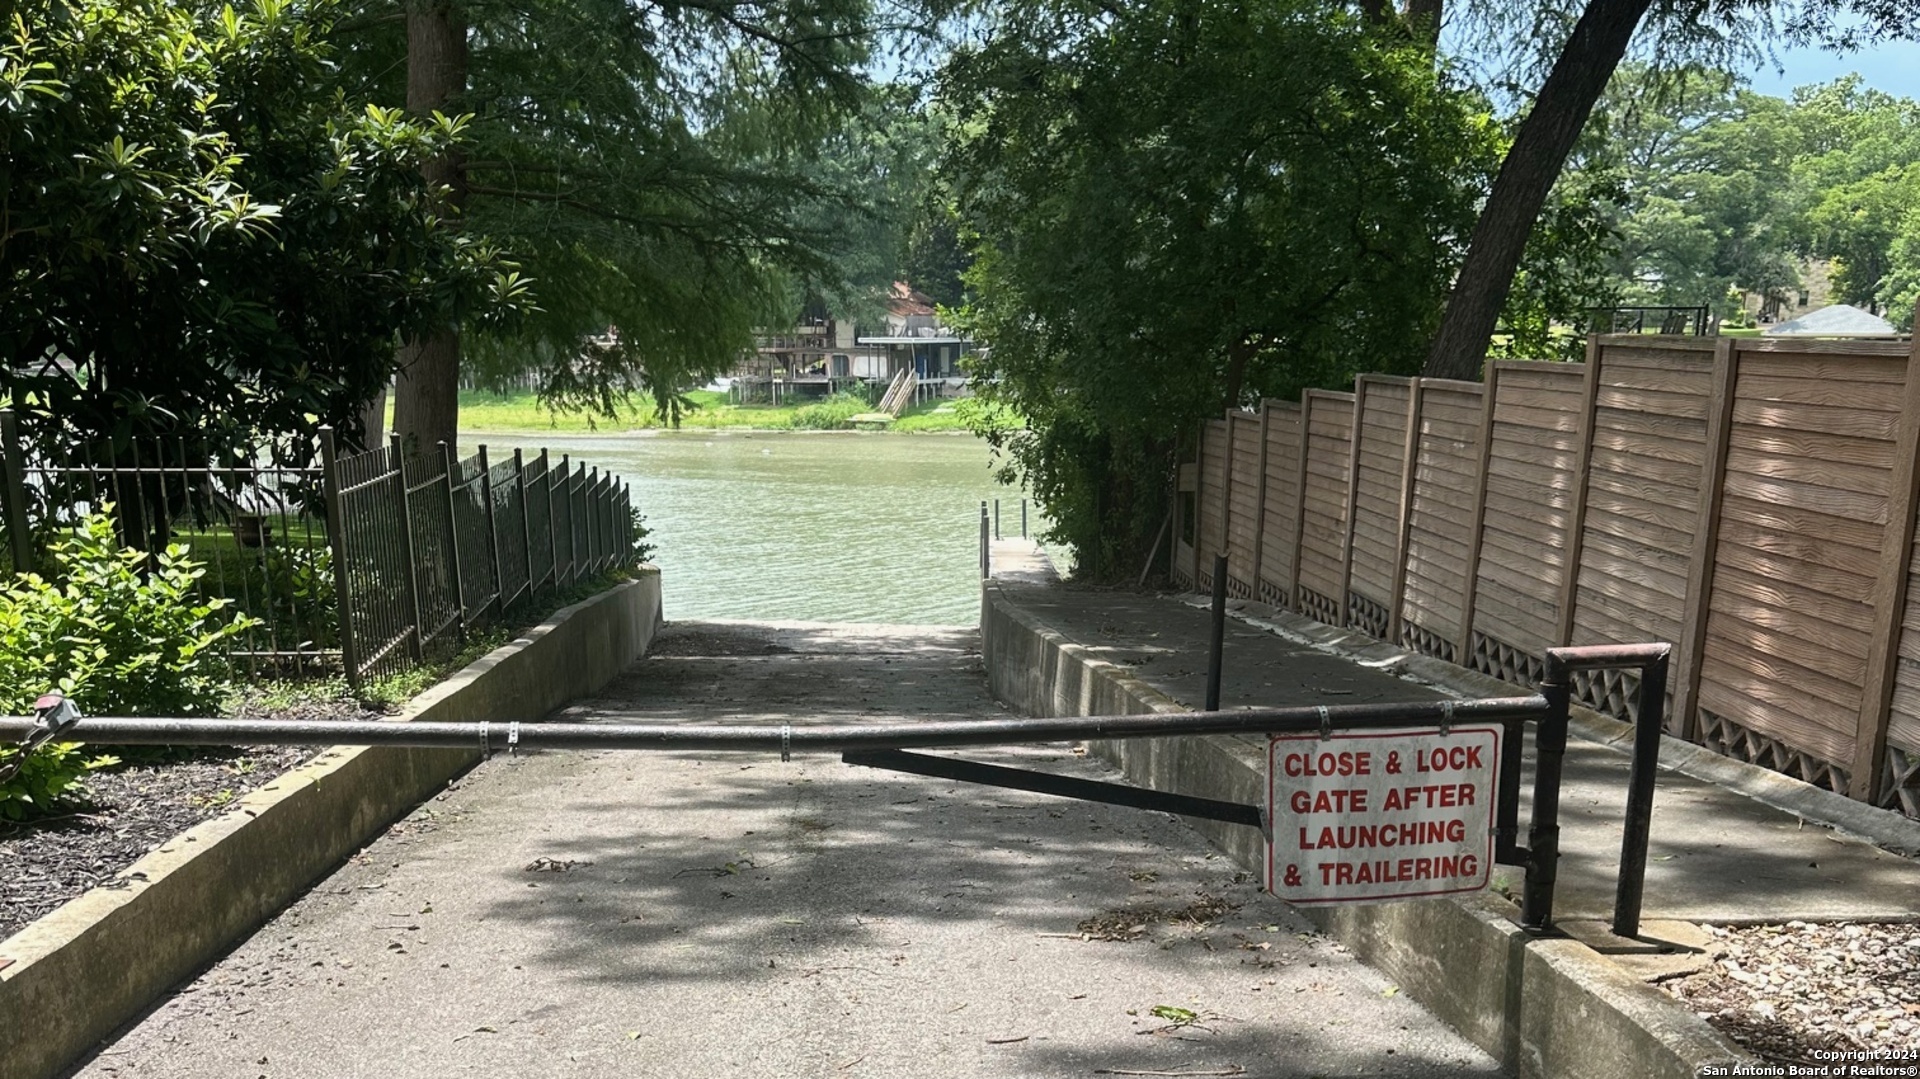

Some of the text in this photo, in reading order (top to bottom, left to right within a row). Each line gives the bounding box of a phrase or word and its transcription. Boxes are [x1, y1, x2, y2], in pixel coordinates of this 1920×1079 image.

[1284, 745, 1483, 777] CLOSE & LOCK
[1290, 783, 1476, 814] GATE AFTER
[1299, 819, 1465, 850] LAUNCHING
[1283, 855, 1478, 887] & TRAILERING
